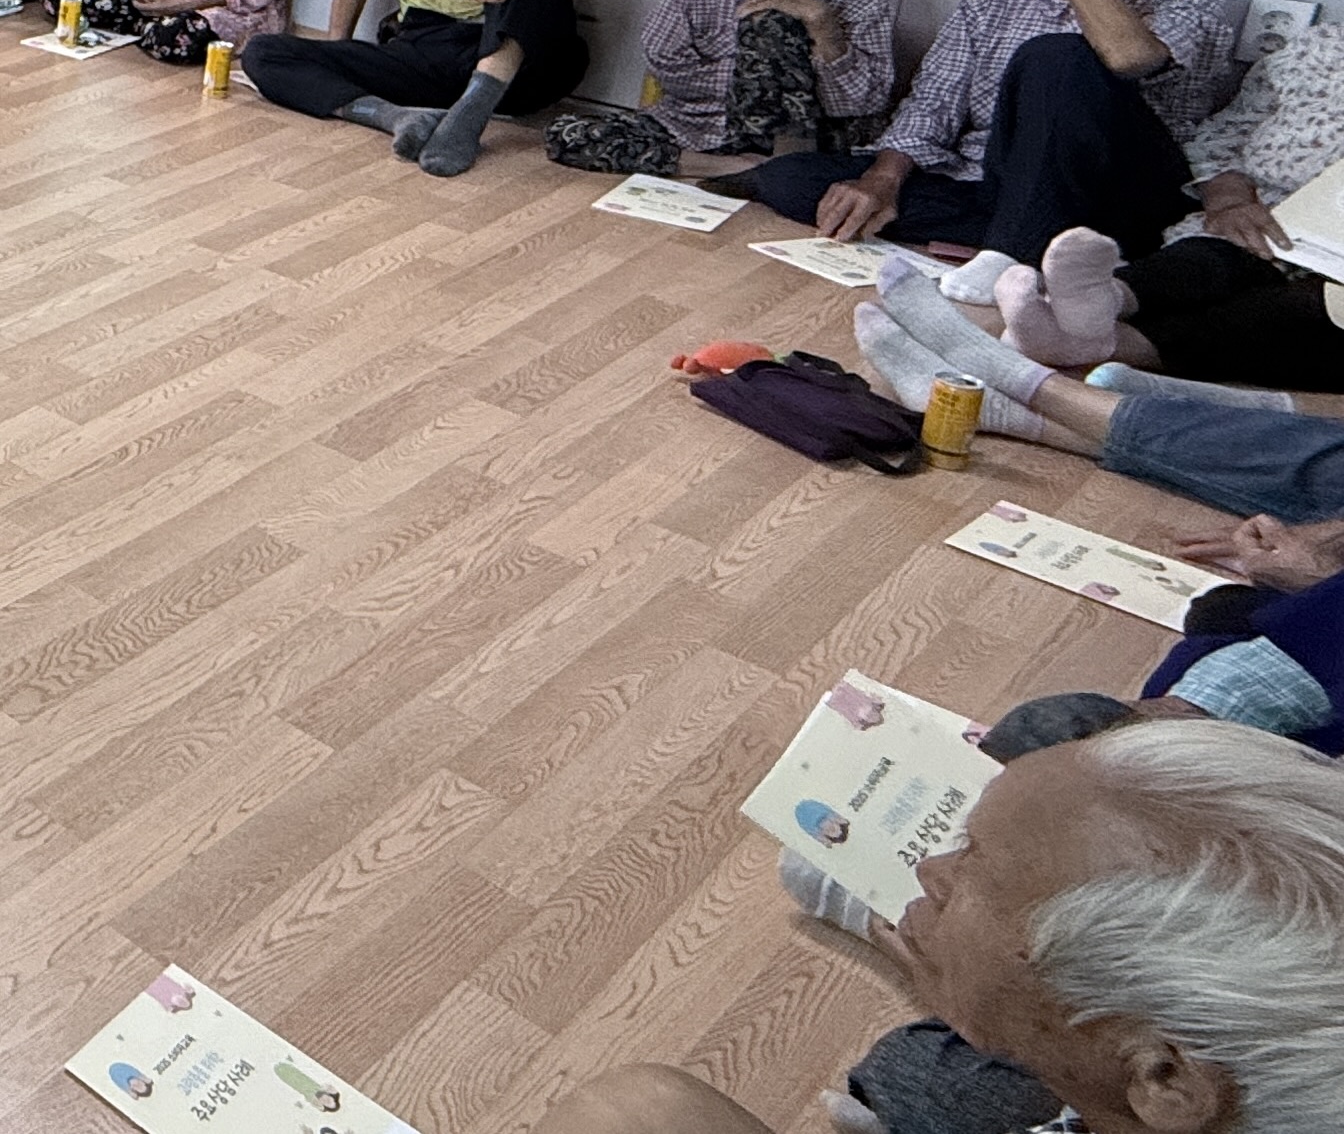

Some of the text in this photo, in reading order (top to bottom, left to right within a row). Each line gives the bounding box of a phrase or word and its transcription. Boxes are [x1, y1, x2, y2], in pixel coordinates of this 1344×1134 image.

[190, 1058, 255, 1122] 주요 상담 사례
